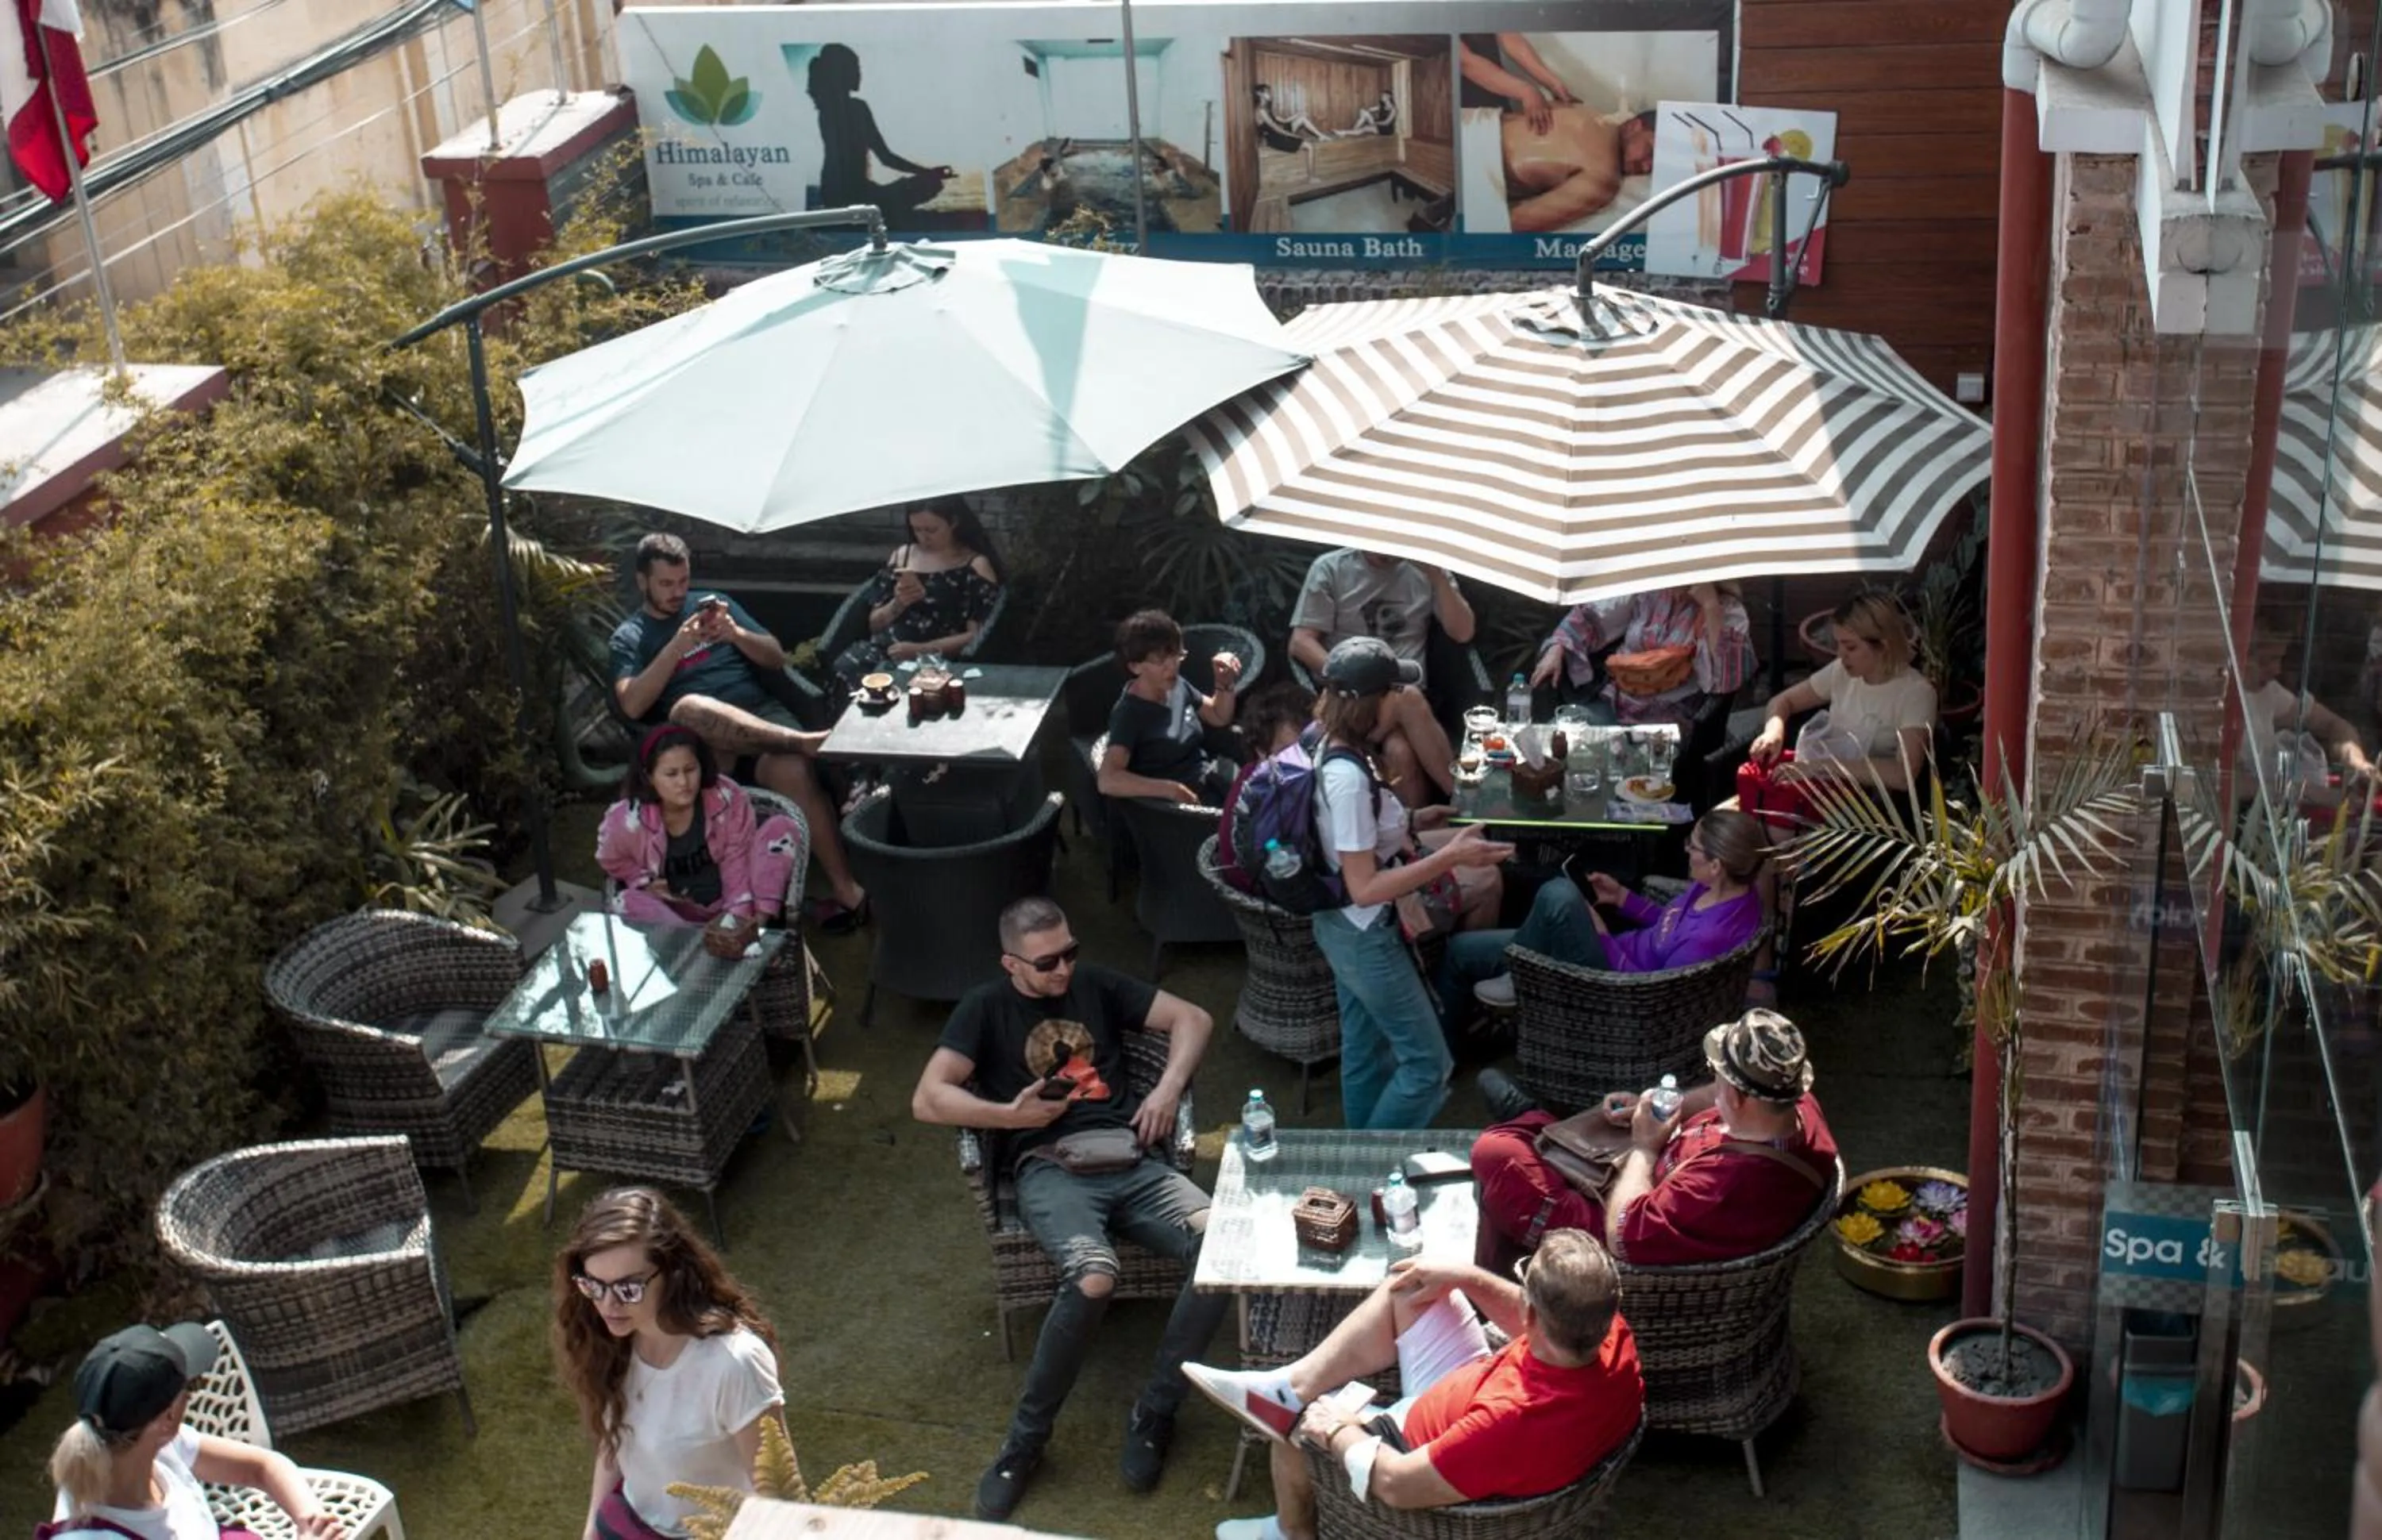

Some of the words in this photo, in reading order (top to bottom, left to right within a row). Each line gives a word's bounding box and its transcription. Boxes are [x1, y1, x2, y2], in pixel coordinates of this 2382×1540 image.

[657, 141, 791, 167] Himalayan
[688, 173, 712, 190] Spa
[717, 172, 727, 187] &
[1276, 237, 1355, 257] Sauna
[1363, 237, 1423, 257] Bath
[1534, 237, 1646, 263] Maage
[2104, 1227, 2183, 1265] Spa
[2195, 1237, 2226, 1269] &
